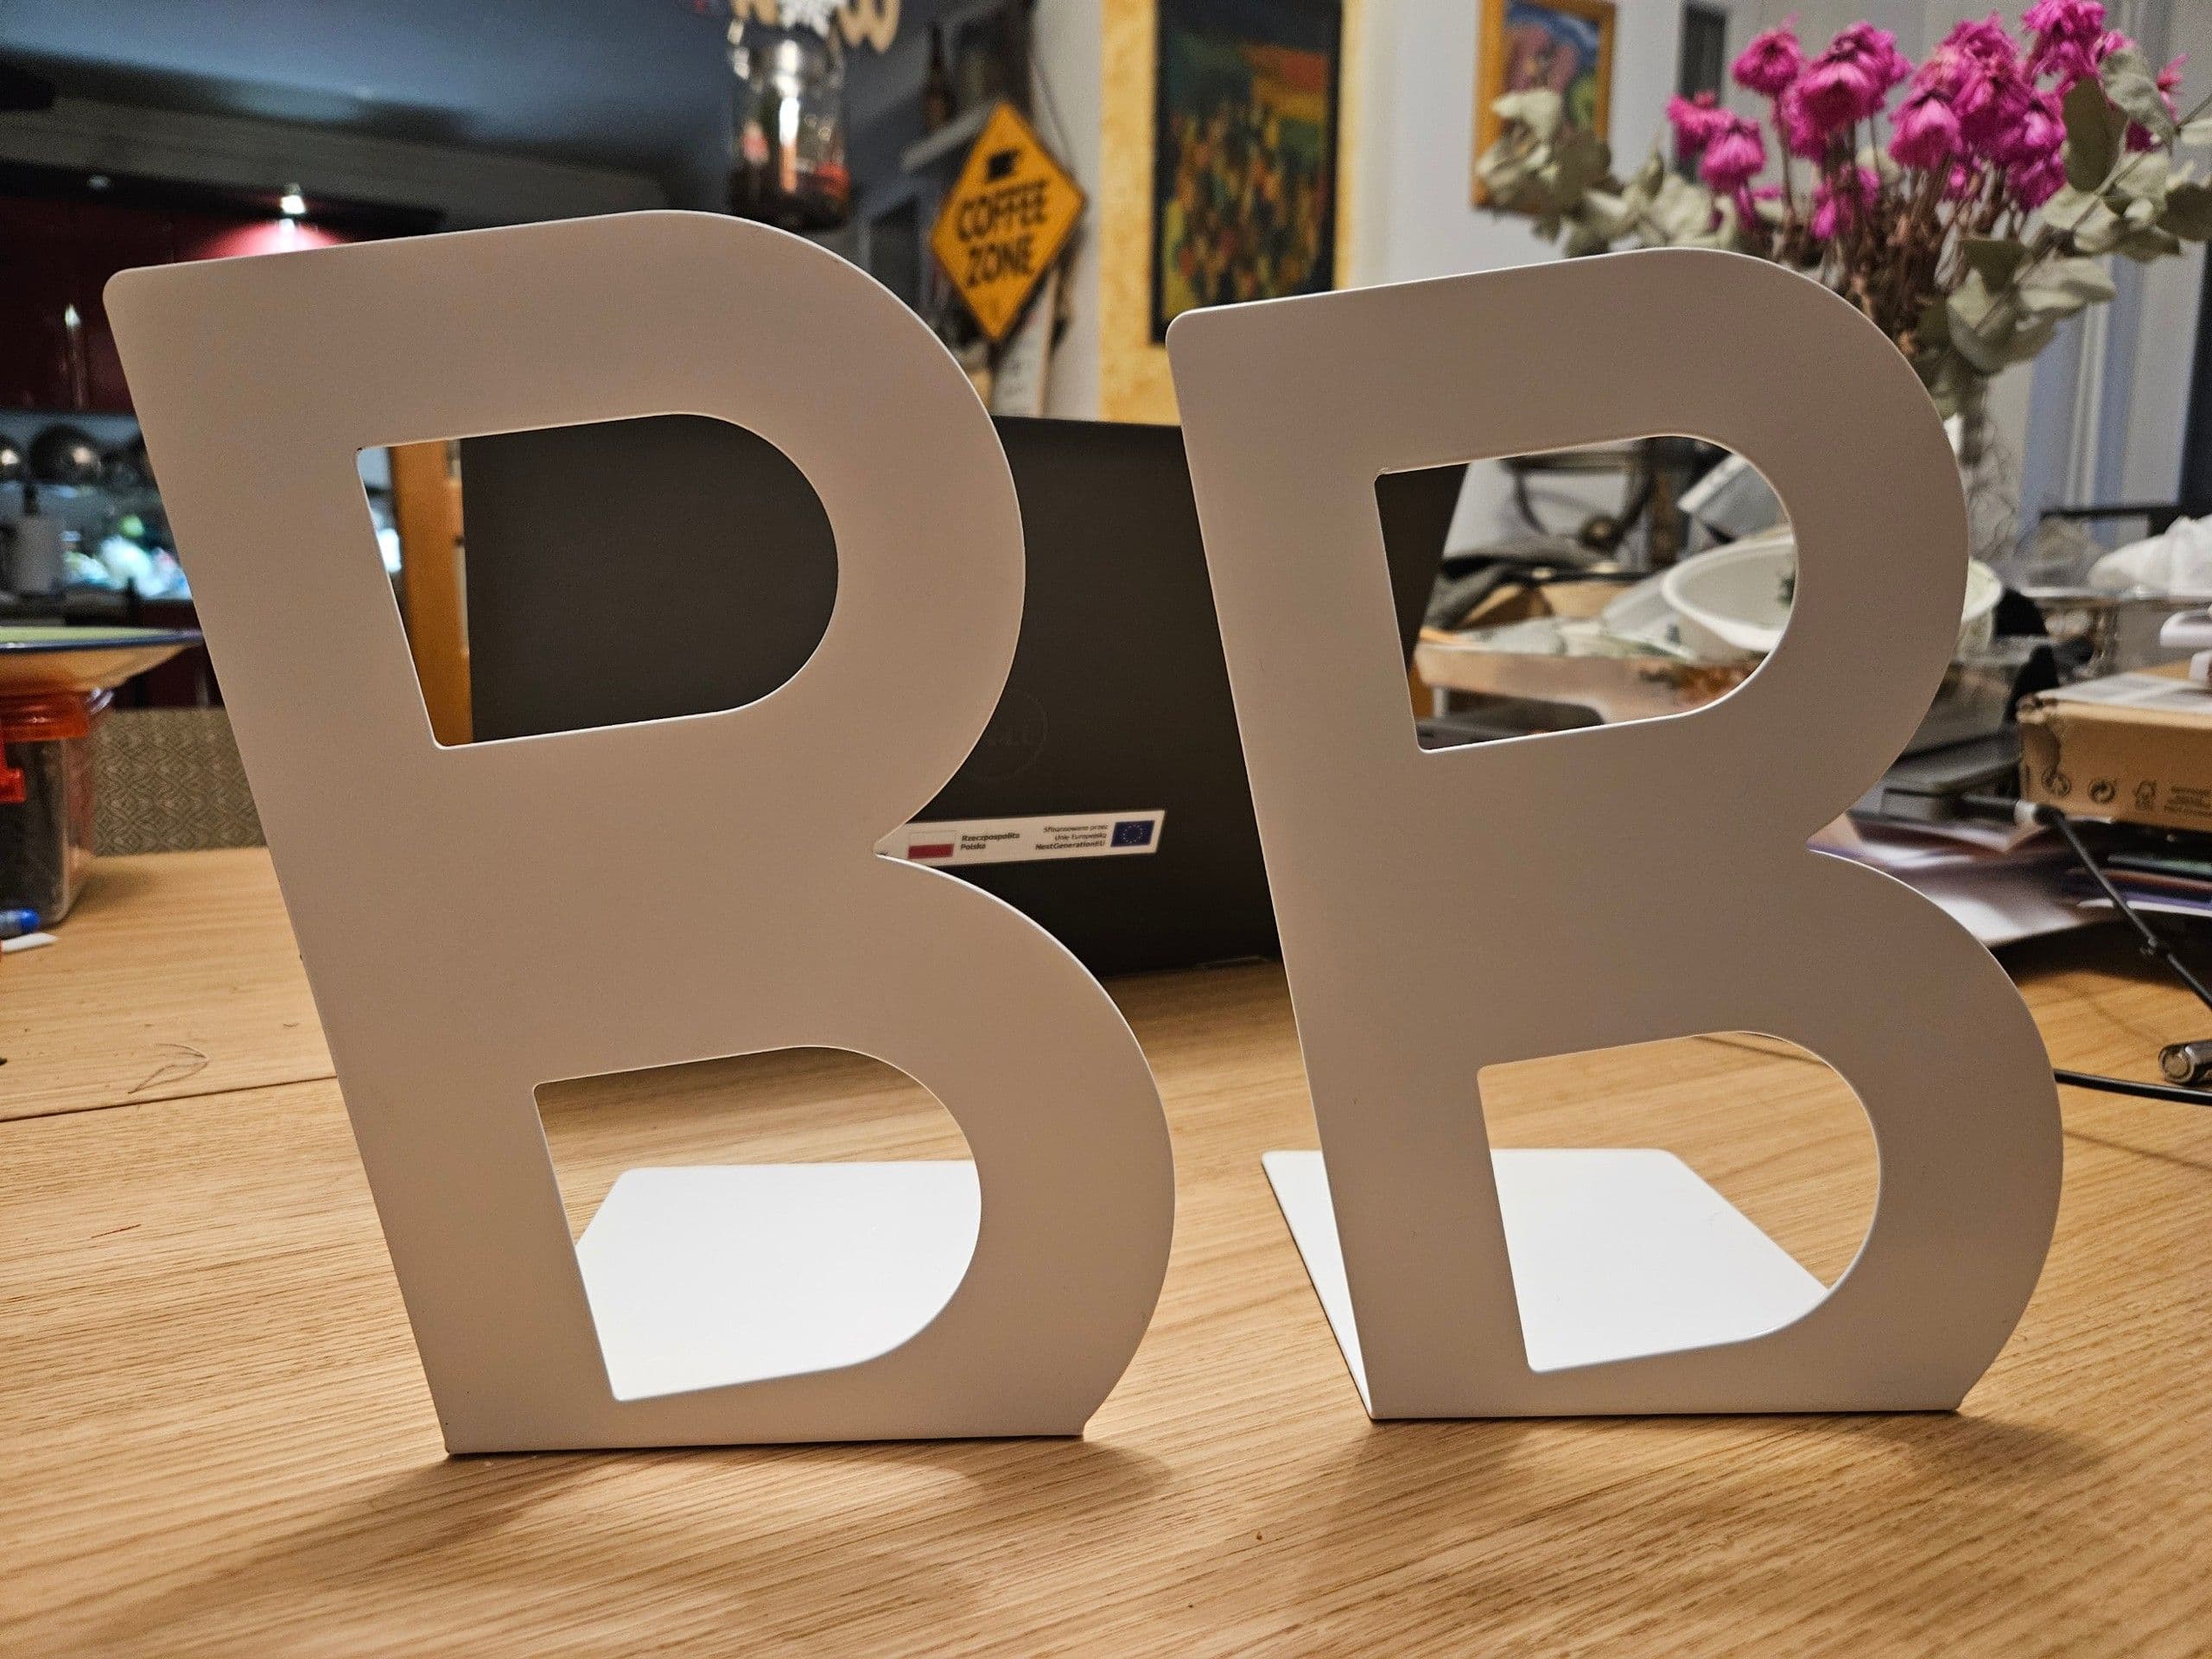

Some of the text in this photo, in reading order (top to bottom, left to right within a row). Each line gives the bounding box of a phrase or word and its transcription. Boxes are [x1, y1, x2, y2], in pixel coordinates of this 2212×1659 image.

[957, 180, 1047, 243] COFFEE
[966, 234, 1034, 288] ZONE
[104, 210, 1175, 1455] B
[961, 842, 986, 851] Polska
[962, 832, 1020, 842] Rzeczpospolita
[1166, 248, 2063, 1421] B
